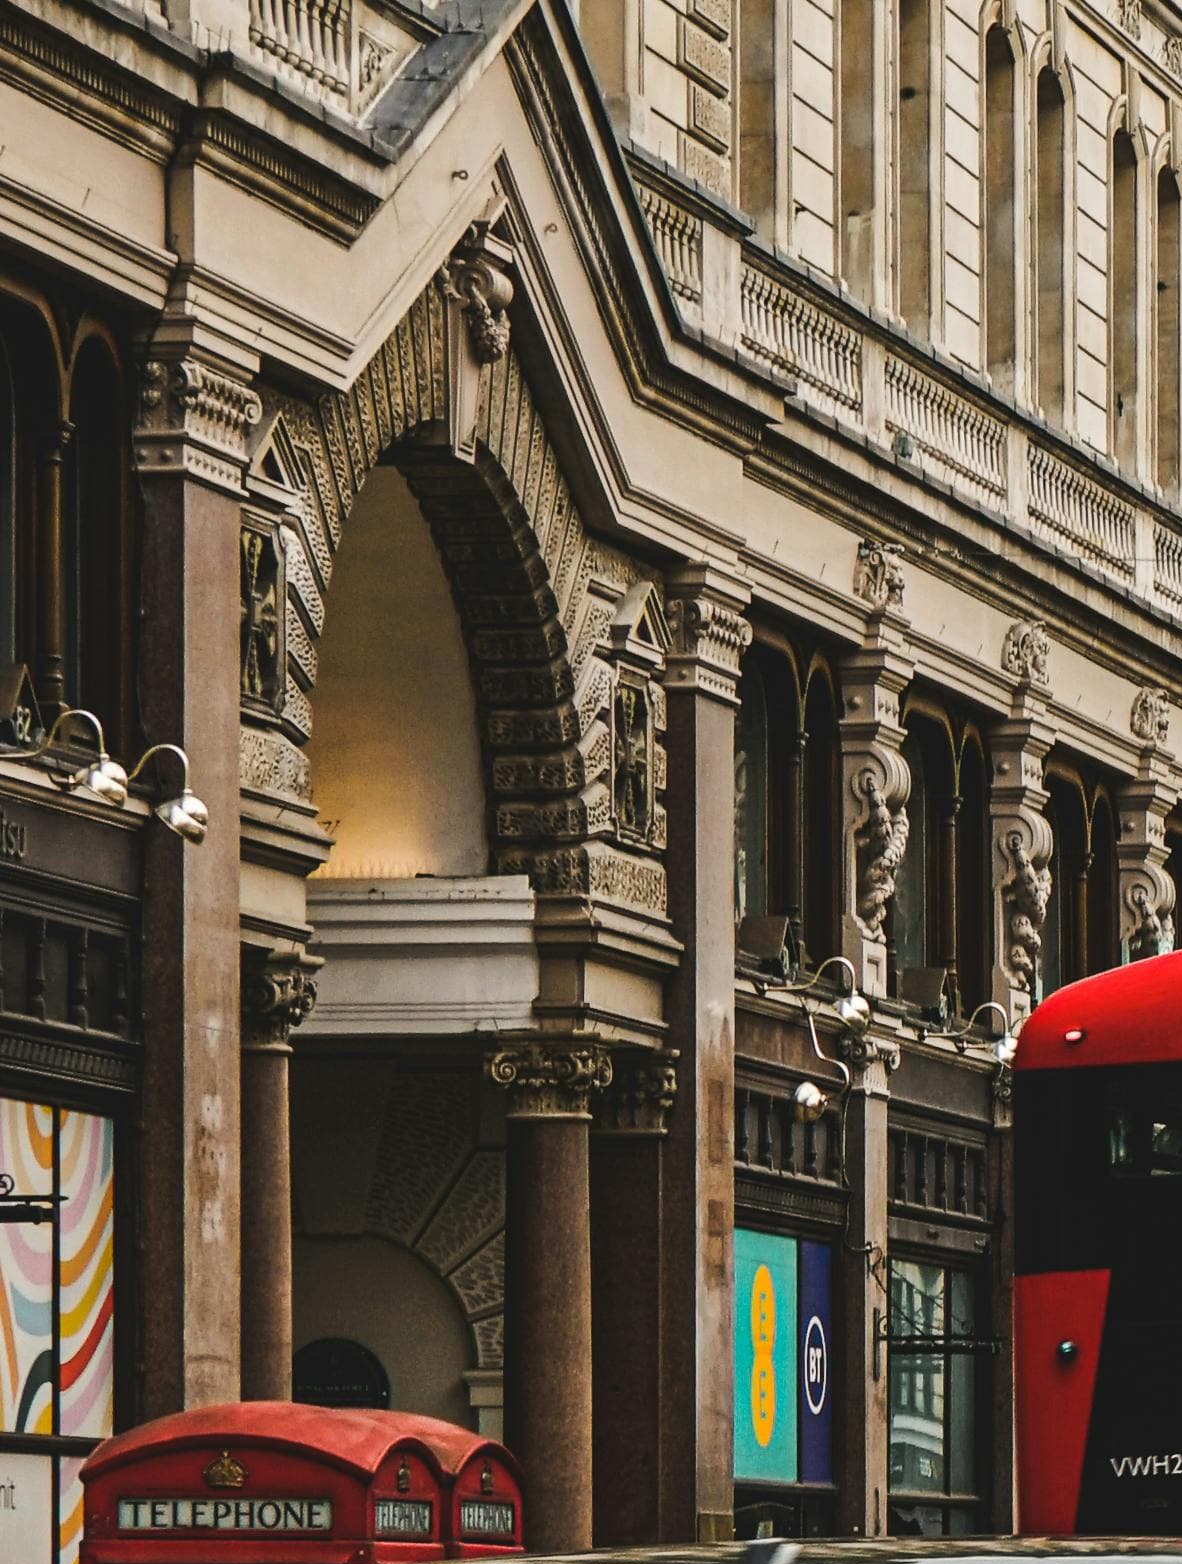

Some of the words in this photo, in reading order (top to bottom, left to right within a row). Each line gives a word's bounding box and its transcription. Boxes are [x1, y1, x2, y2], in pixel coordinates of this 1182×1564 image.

[809, 1347, 823, 1384] BT
[125, 1501, 325, 1530] TELEPHONE
[375, 1502, 430, 1532] TELEPHONE
